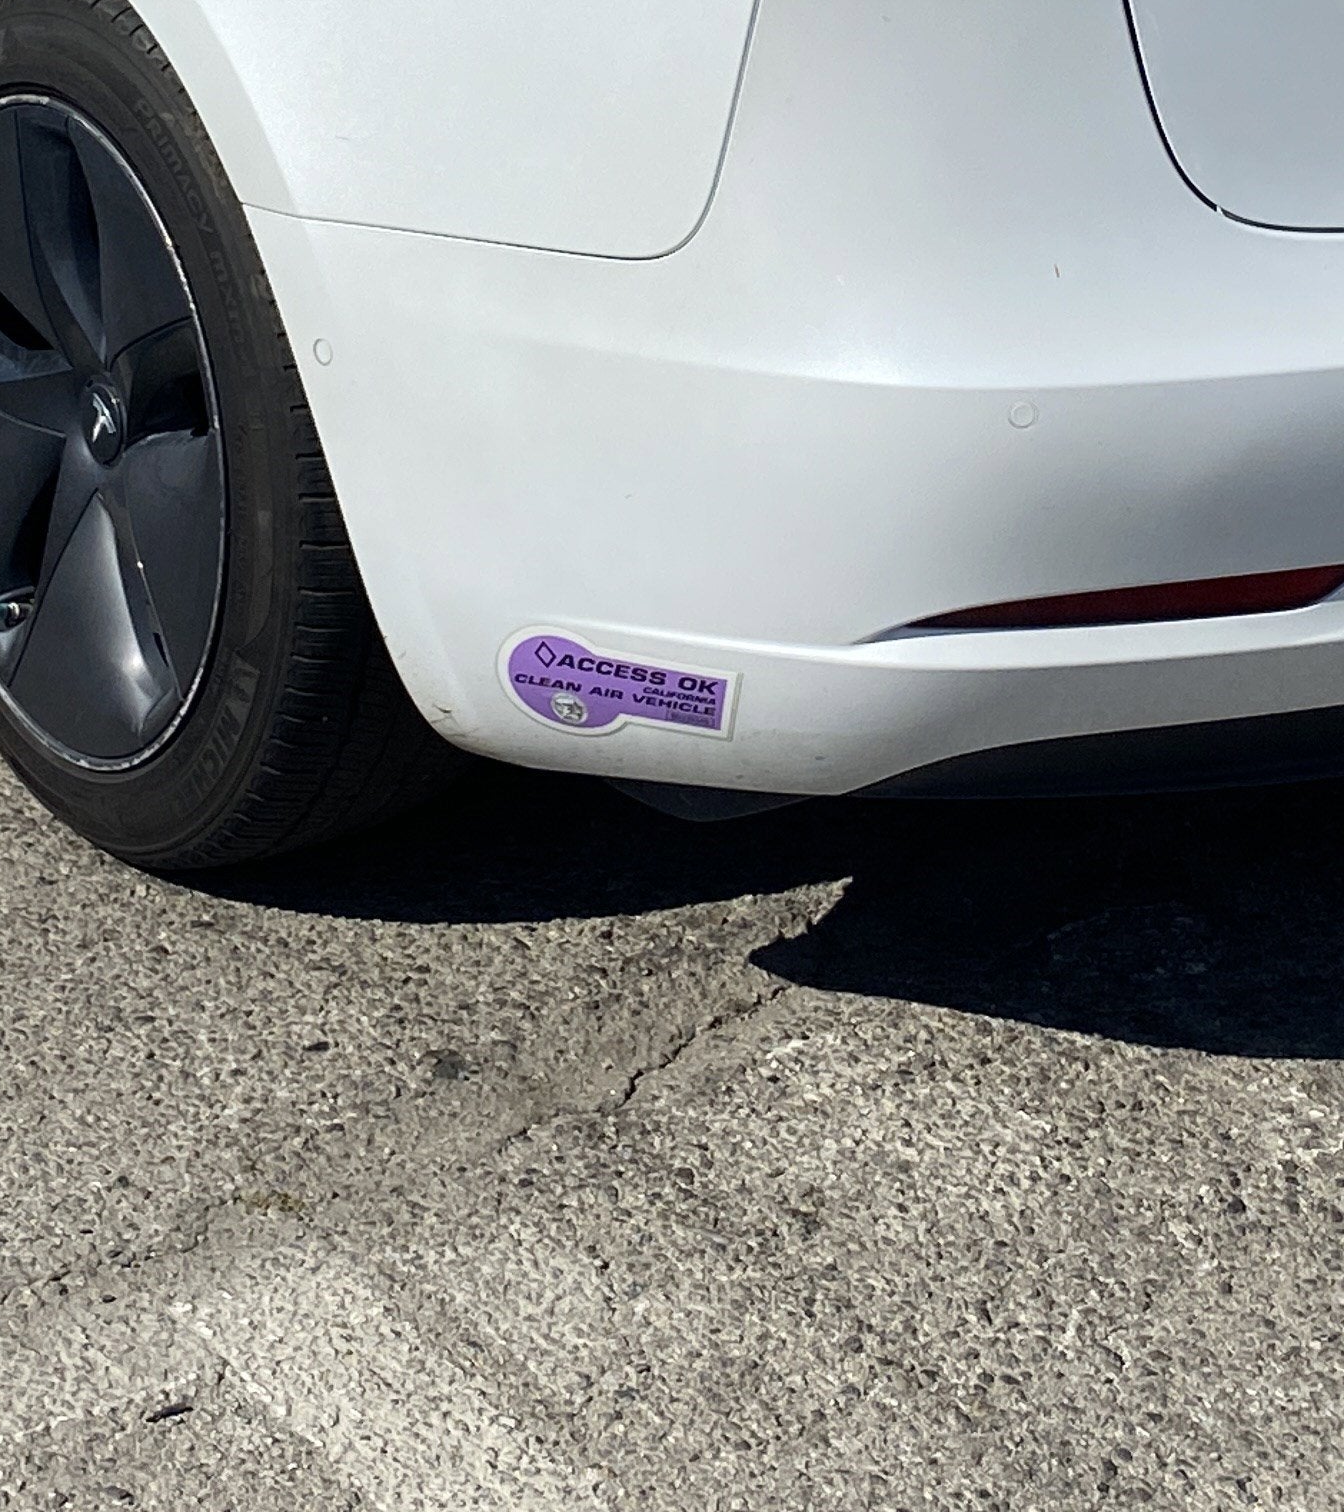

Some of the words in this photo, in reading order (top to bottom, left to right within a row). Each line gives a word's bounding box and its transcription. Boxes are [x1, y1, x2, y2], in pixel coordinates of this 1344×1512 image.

[514, 673, 582, 693] CLEAN
[588, 686, 623, 700] AIR
[632, 693, 717, 716] VEHICLE
[557, 654, 667, 686] ACCESS
[677, 676, 719, 695] OK
[642, 686, 716, 706] CALIFORNIA
